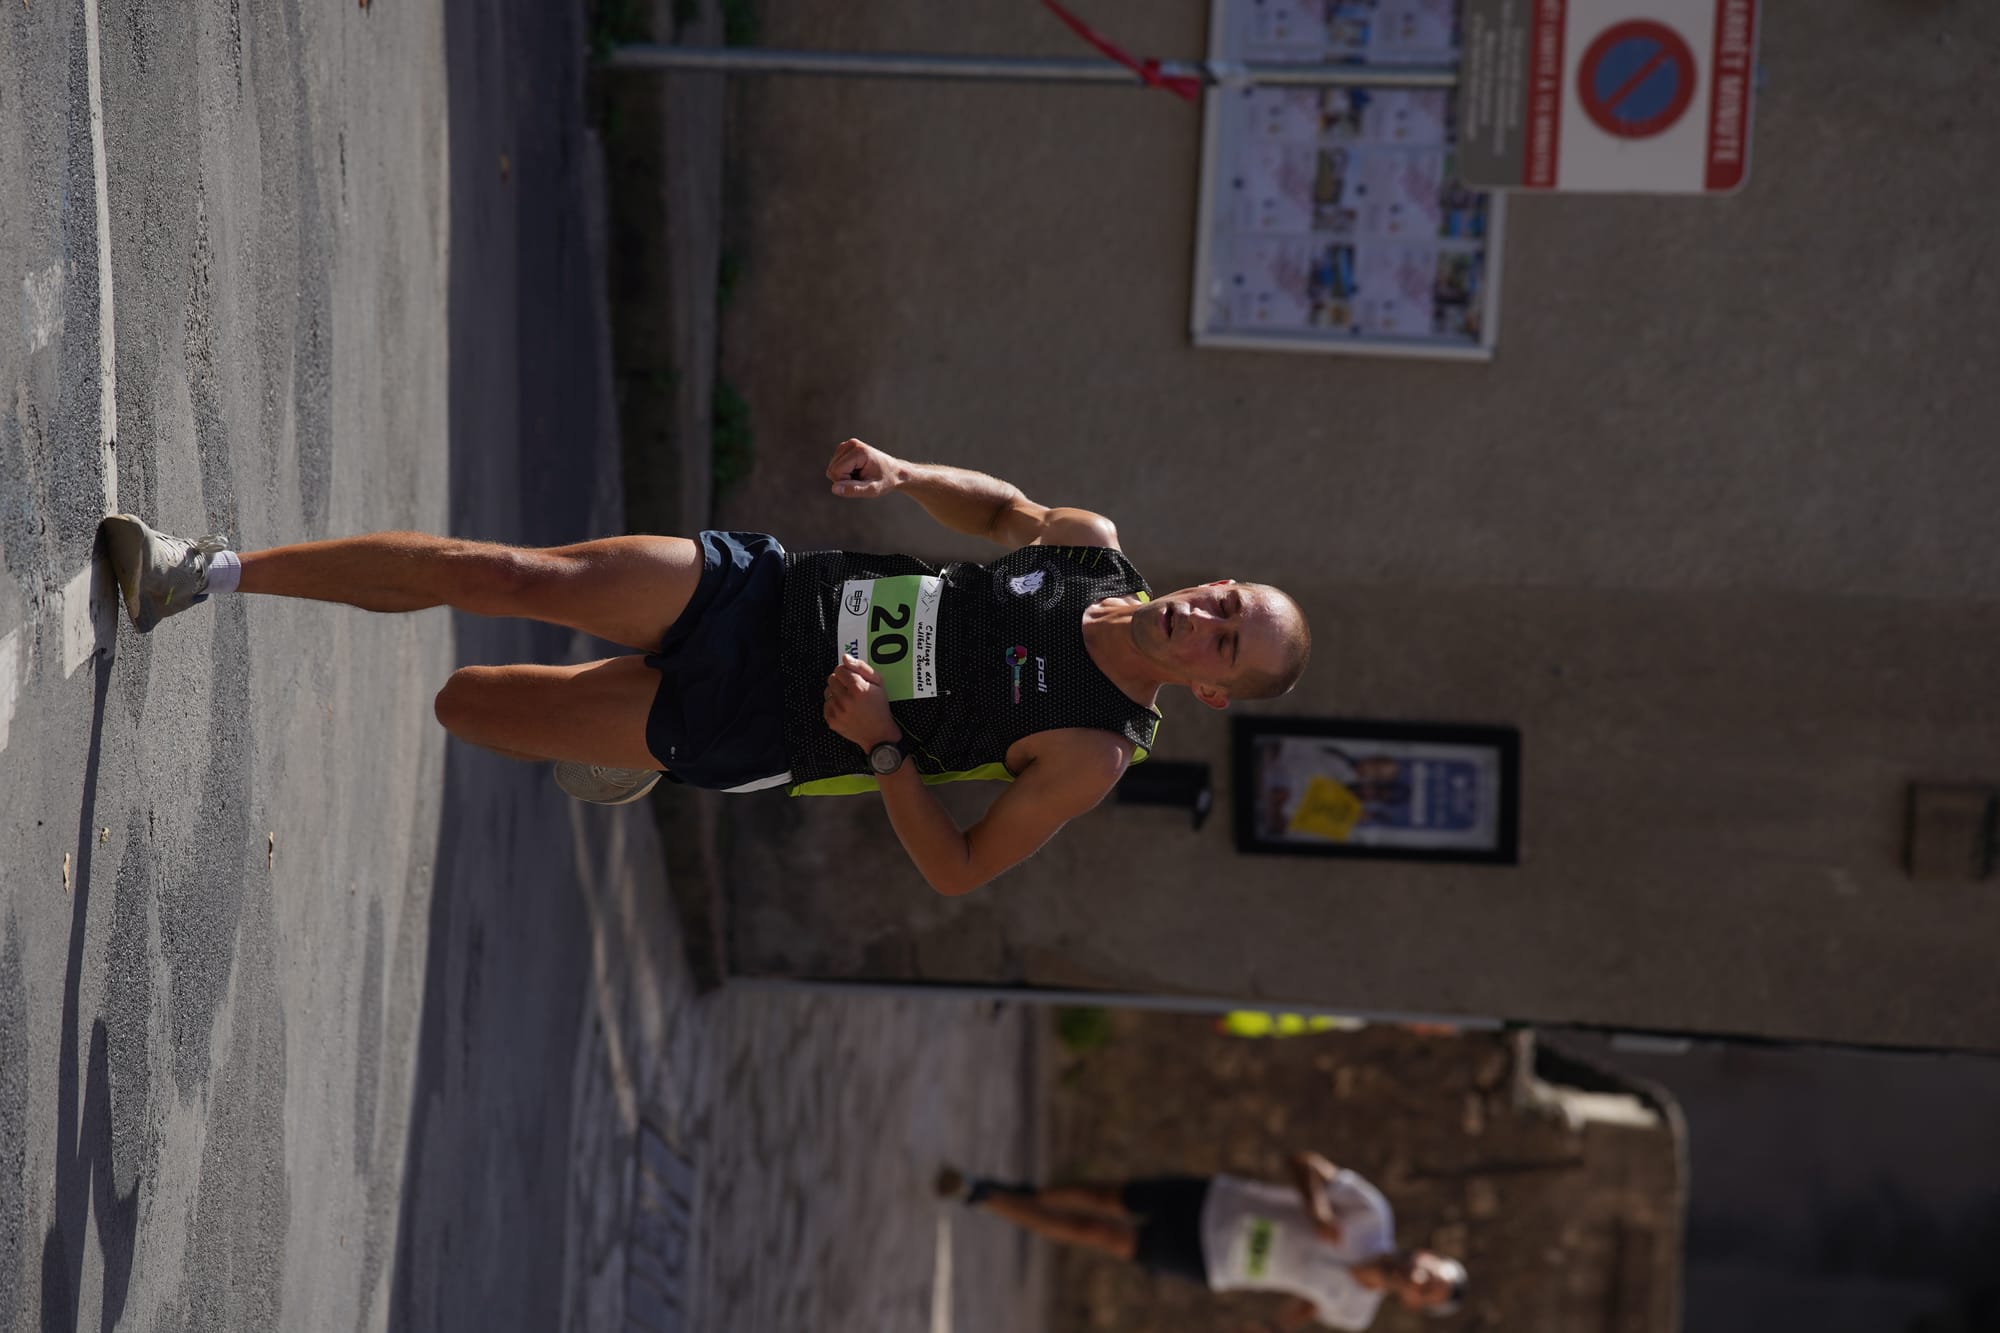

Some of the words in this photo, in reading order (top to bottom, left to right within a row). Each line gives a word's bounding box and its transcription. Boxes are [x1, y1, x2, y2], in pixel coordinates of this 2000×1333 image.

[1712, 74, 1745, 164] MINUTE
[852, 590, 863, 612] BFP
[870, 603, 911, 665] 20
[922, 625, 933, 667] Challenge
[925, 671, 933, 686] des
[1035, 656, 1048, 693] poli
